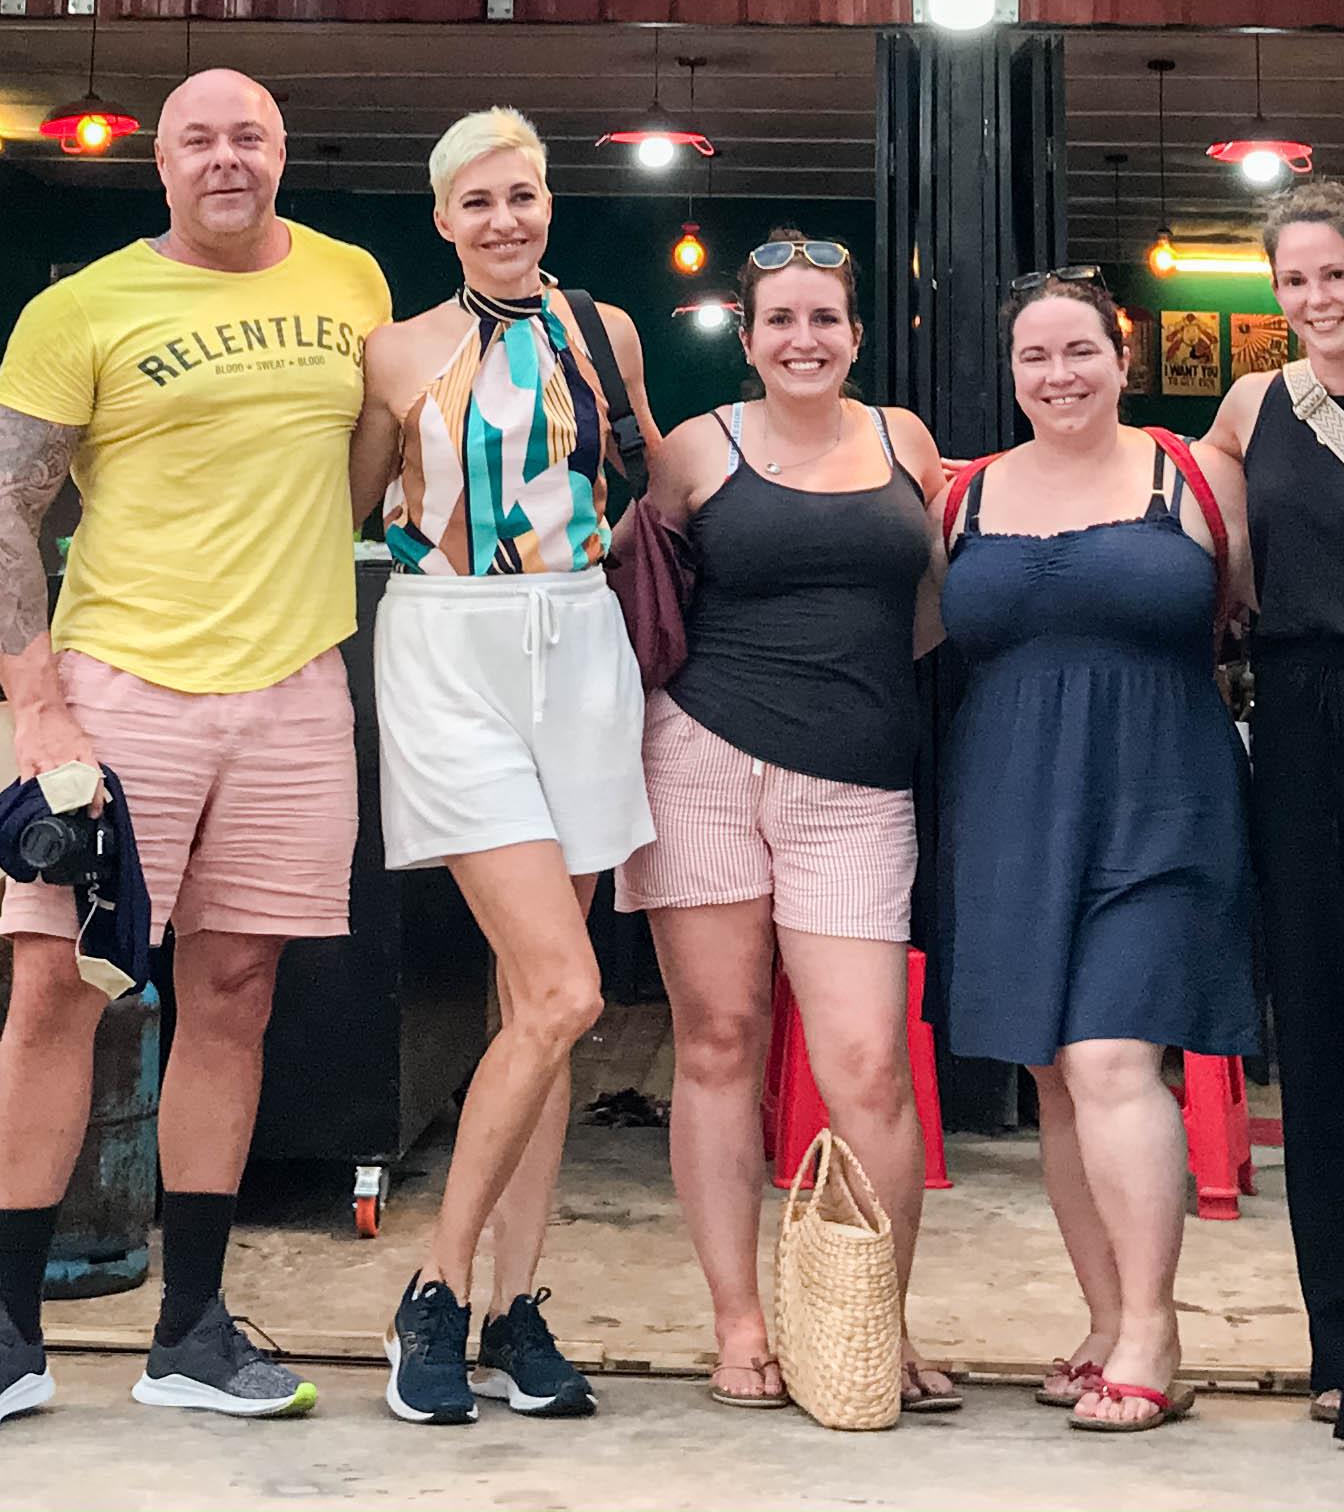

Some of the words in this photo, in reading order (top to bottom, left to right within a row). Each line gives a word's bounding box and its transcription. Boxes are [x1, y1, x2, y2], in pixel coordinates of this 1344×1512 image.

[136, 315, 366, 387] RELENTLESS
[255, 359, 286, 372] SWEAT
[1169, 364, 1199, 377] WANT
